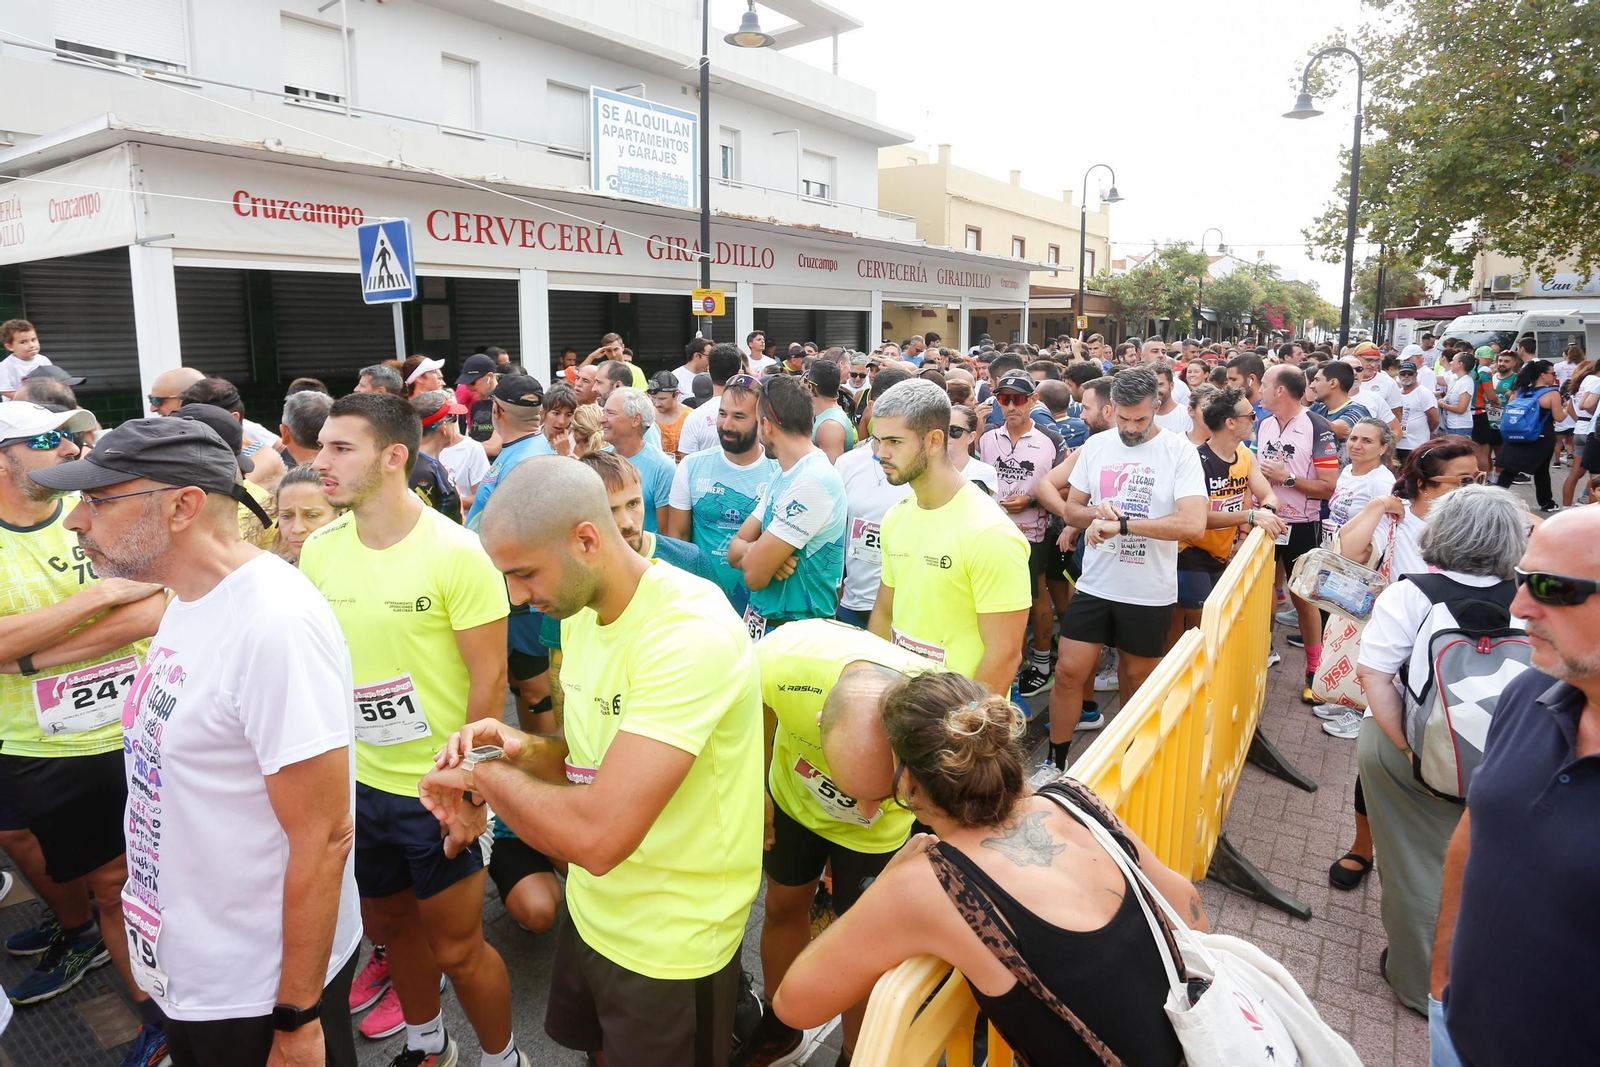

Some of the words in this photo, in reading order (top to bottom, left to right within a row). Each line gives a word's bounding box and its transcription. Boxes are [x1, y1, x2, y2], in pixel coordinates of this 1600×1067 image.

[602, 104, 620, 122] SE
[624, 109, 690, 138] ALQUILAN
[602, 124, 689, 154] APARTAMENTOS
[628, 144, 677, 165] GARAJES
[48, 192, 101, 223] Cruzcampo
[233, 190, 364, 229] Cruzcampo
[426, 208, 624, 256] CERVECERÍA
[646, 233, 776, 270] GIRADILLO
[798, 253, 839, 273] Cruzcampo
[857, 258, 928, 284] CERVECERÍA
[936, 268, 991, 289] GIRALDILLO
[1541, 279, 1573, 292] Can
[695, 484, 726, 496] RUNNERS
[358, 694, 416, 722] 561
[128, 927, 158, 970] 19
